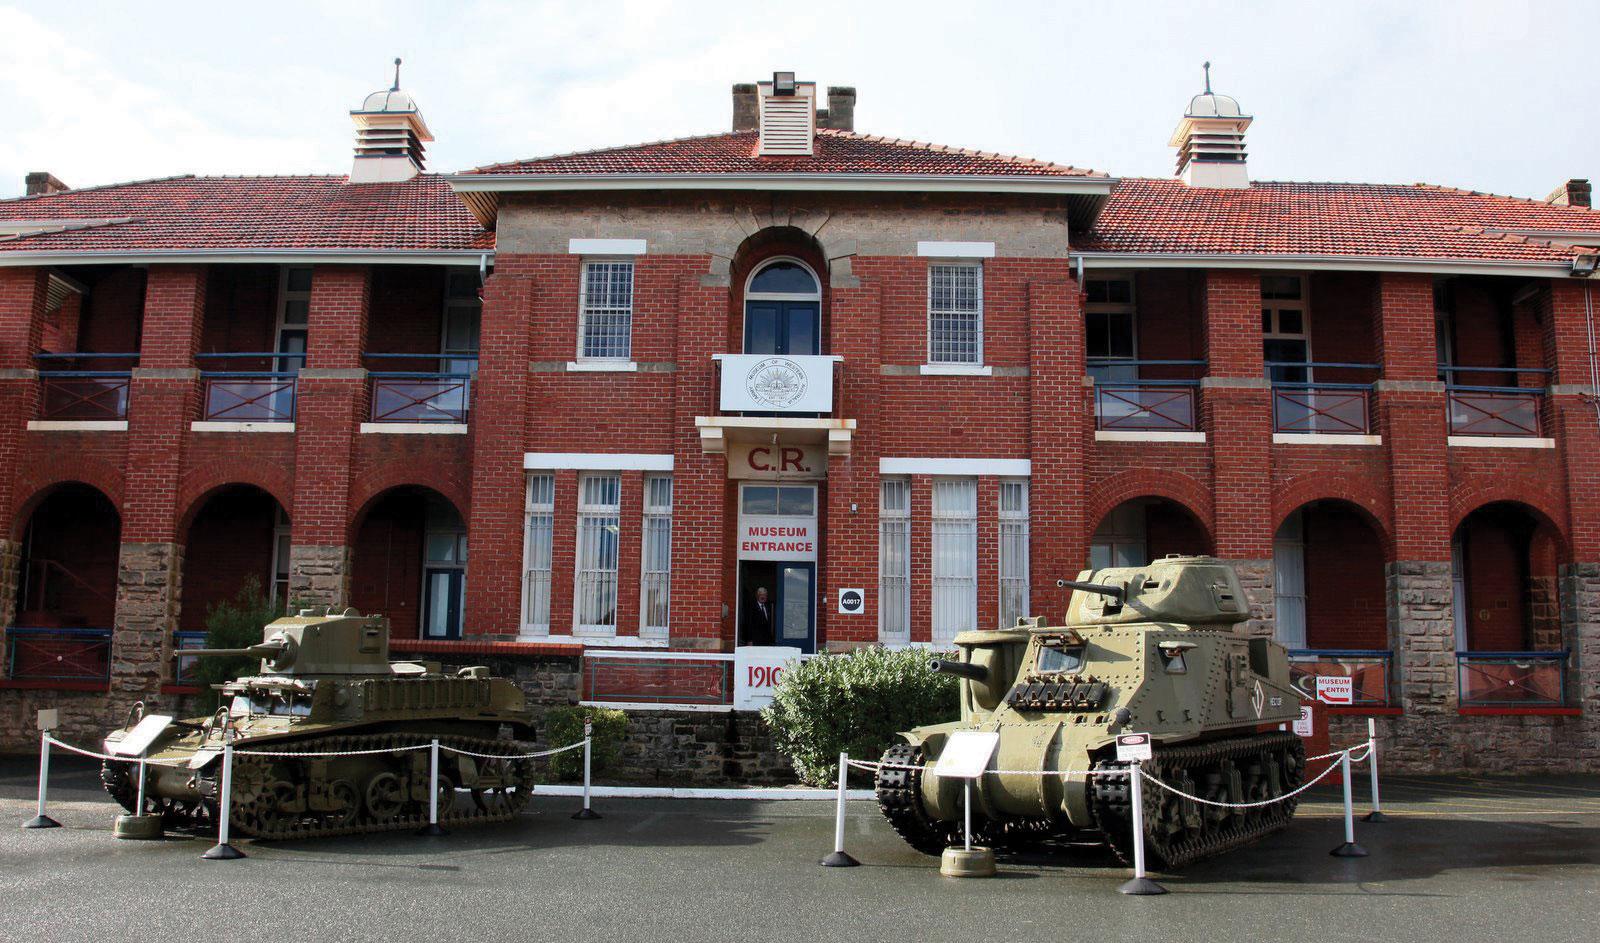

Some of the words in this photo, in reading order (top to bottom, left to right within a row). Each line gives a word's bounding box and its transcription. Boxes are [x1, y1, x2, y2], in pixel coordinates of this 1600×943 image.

[748, 362, 766, 380] MUSEUM
[784, 361, 804, 380] WESTERN
[747, 447, 811, 472] C.R.
[748, 527, 807, 537] MUSEUM
[742, 542, 813, 552] ENTRANCE
